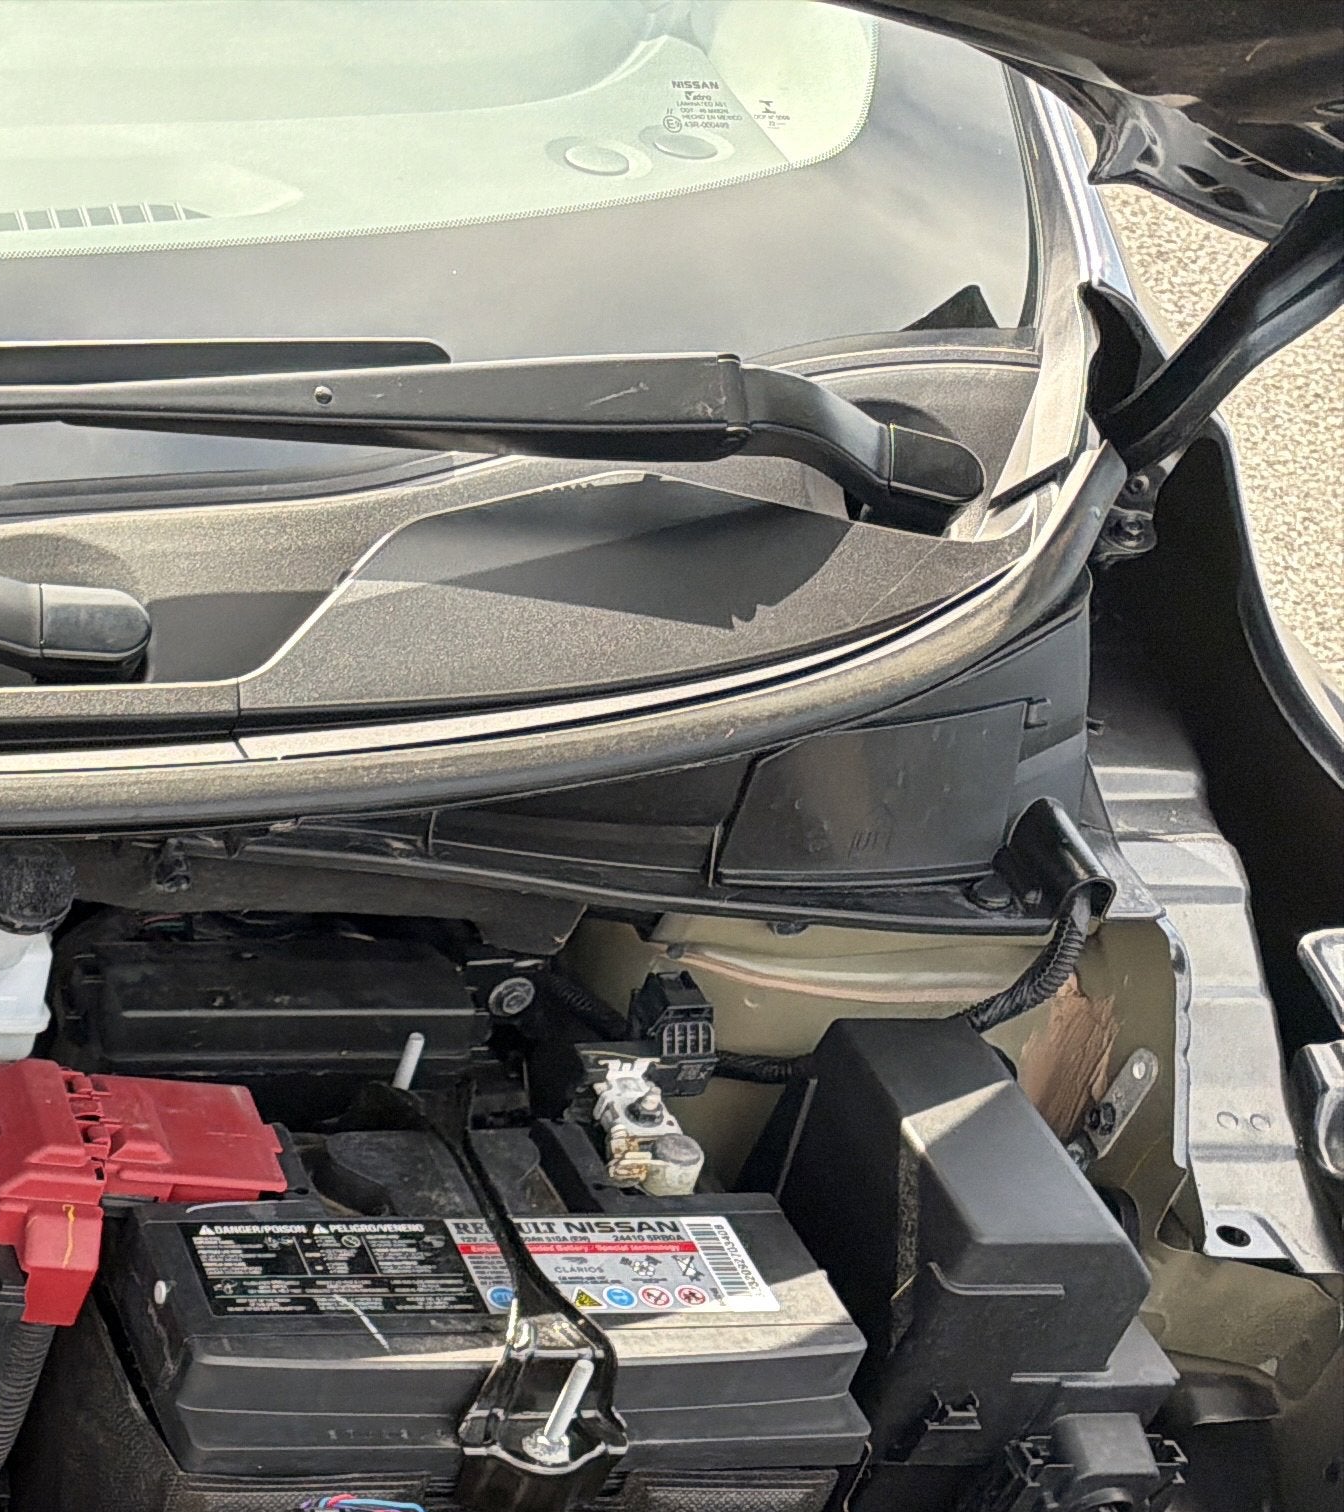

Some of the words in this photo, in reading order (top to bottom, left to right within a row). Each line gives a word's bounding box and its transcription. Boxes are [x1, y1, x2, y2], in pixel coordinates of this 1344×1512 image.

[672, 80, 719, 89] NISSAN
[214, 1224, 307, 1235] DANGER/POISON
[329, 1223, 425, 1233] PELIGRO/VENENO
[563, 1220, 680, 1234] NISSAN
[554, 1265, 605, 1274] CLARIOS
